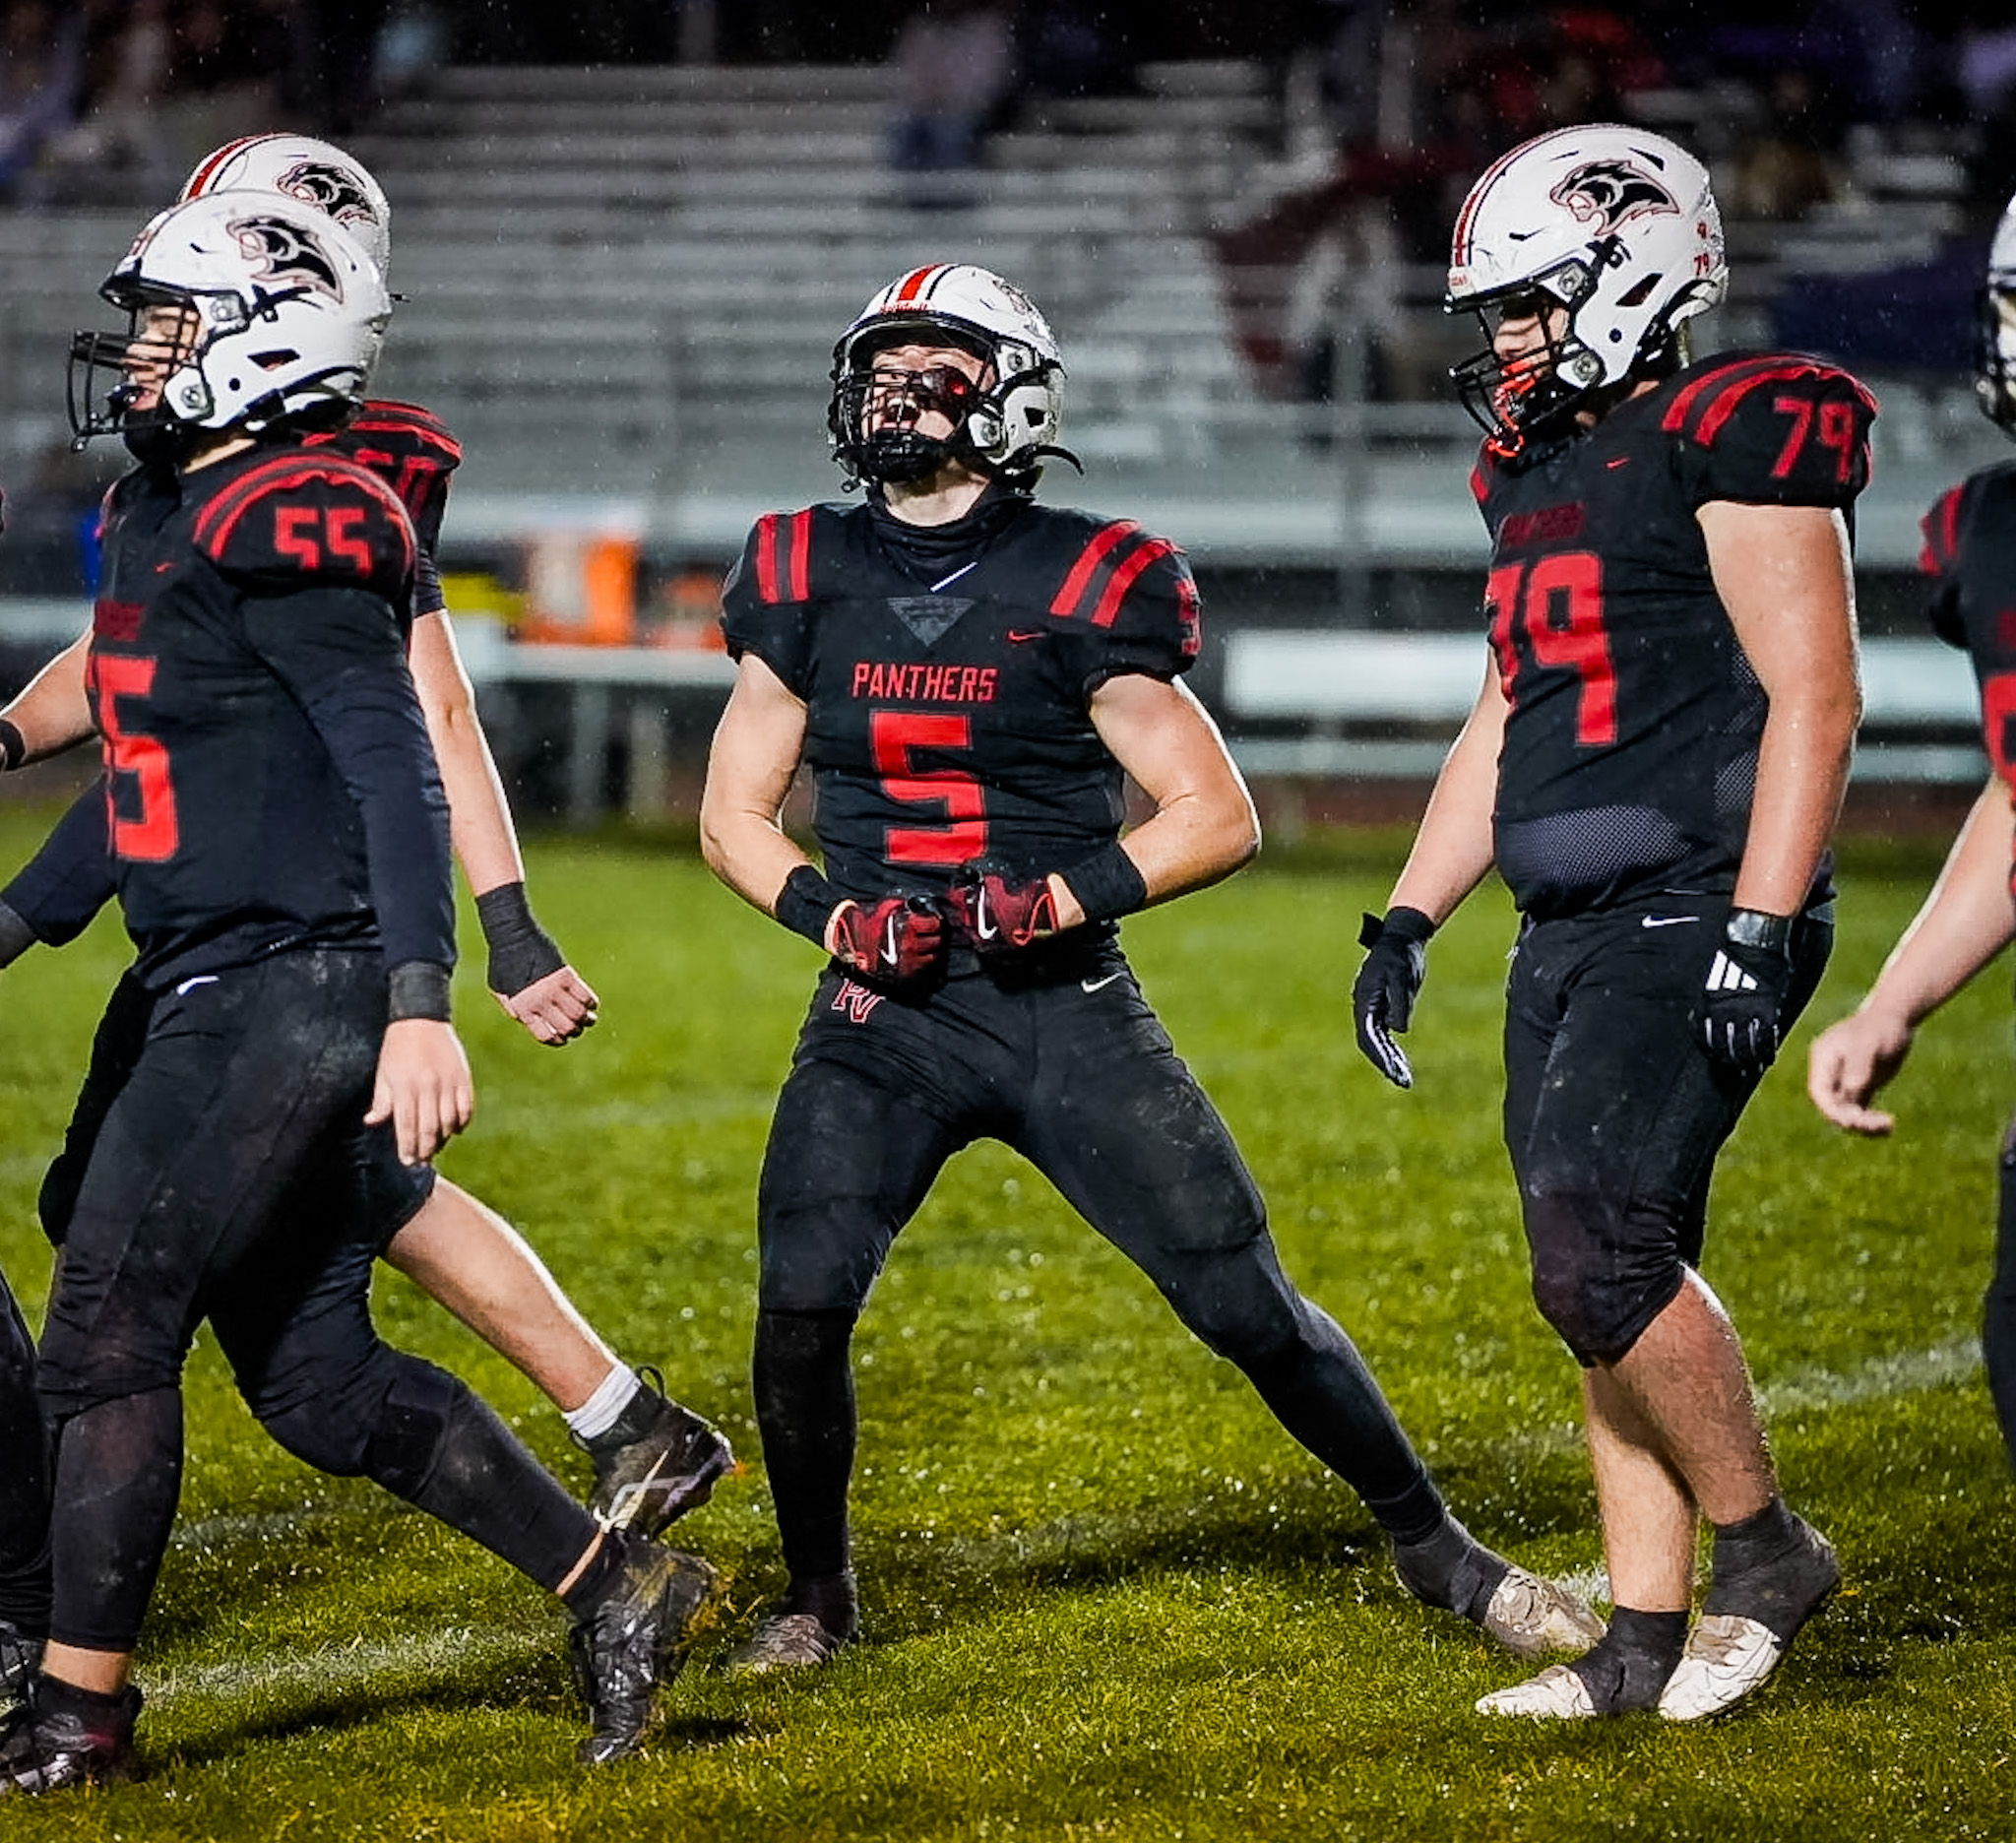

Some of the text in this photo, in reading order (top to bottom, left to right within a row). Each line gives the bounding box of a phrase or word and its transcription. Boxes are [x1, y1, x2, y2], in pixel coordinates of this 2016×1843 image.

[1693, 252, 1710, 278] 79
[1772, 396, 1854, 482] 79
[275, 505, 373, 577] 55
[851, 661, 1000, 703] PANTHERS
[88, 653, 179, 863] 5
[870, 709, 990, 867] 5
